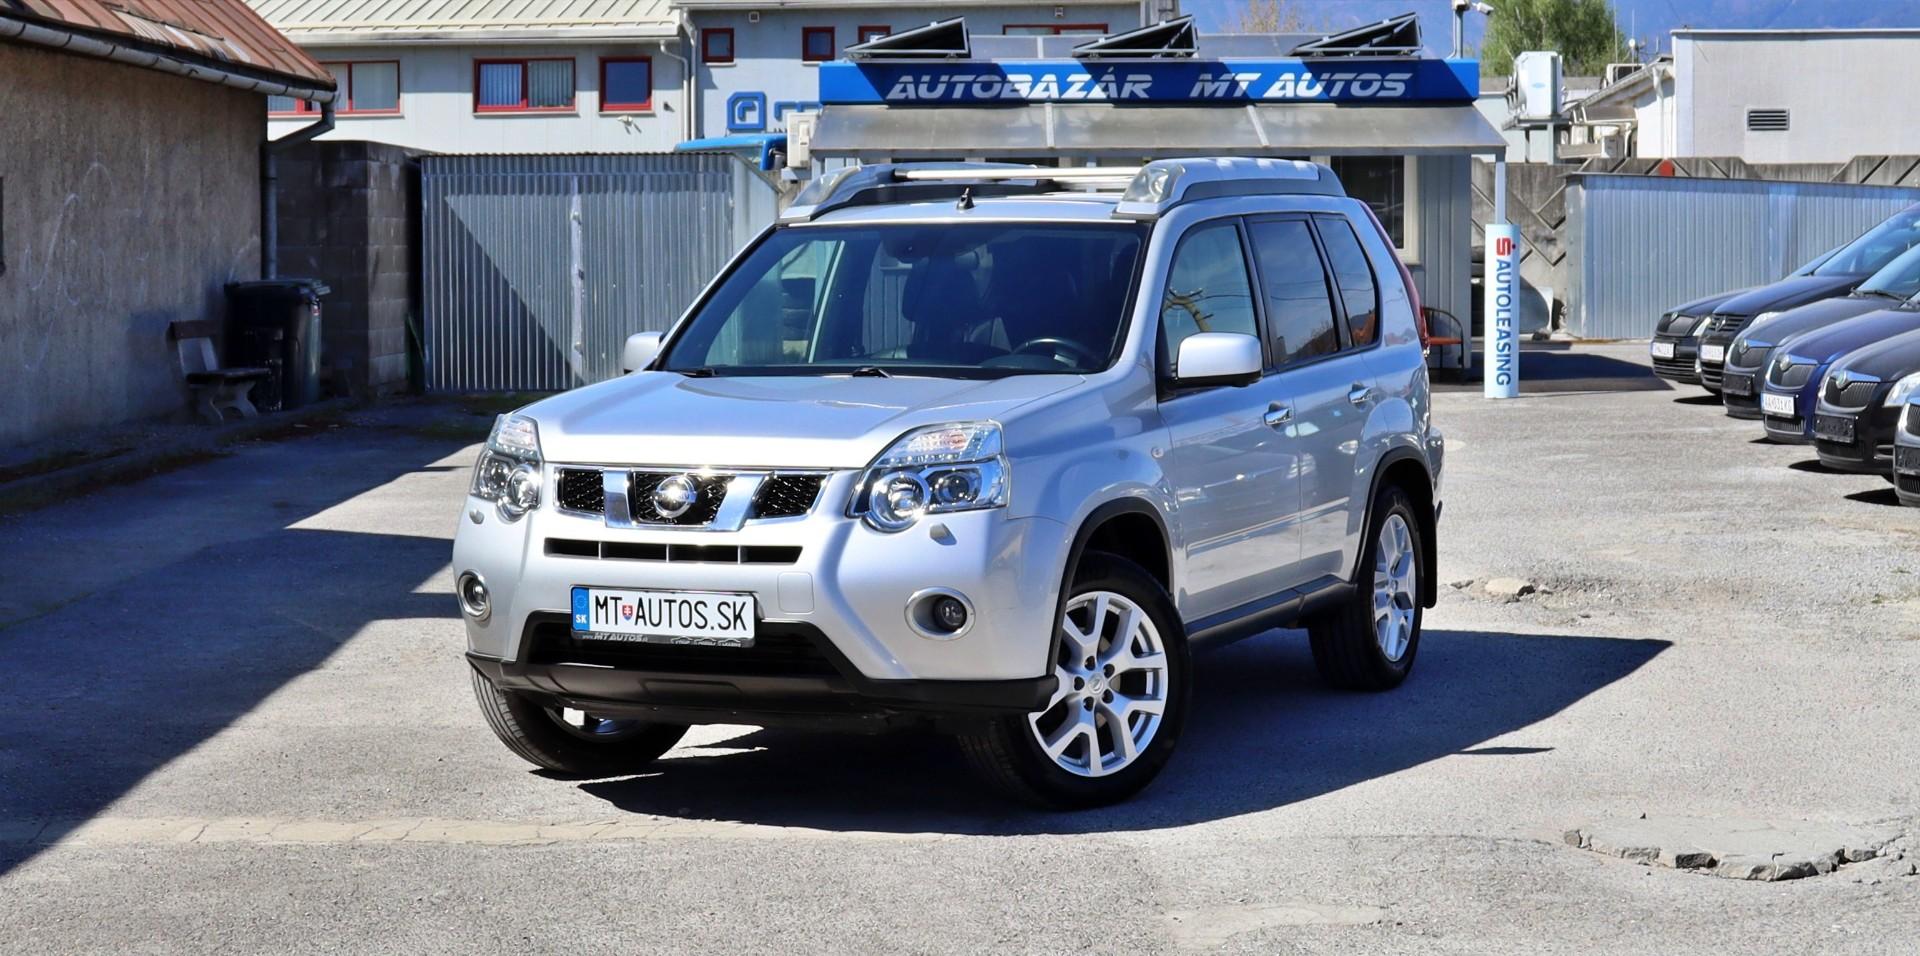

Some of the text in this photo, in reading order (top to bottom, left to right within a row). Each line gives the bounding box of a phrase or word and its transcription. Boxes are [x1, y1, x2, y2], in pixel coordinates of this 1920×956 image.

[886, 67, 1413, 99] AUTOBAZÁR MT AUTOS
[1496, 259, 1512, 386] AUTOLEASING
[575, 614, 587, 624] SK
[595, 595, 747, 631] MT AUTOS.SK
